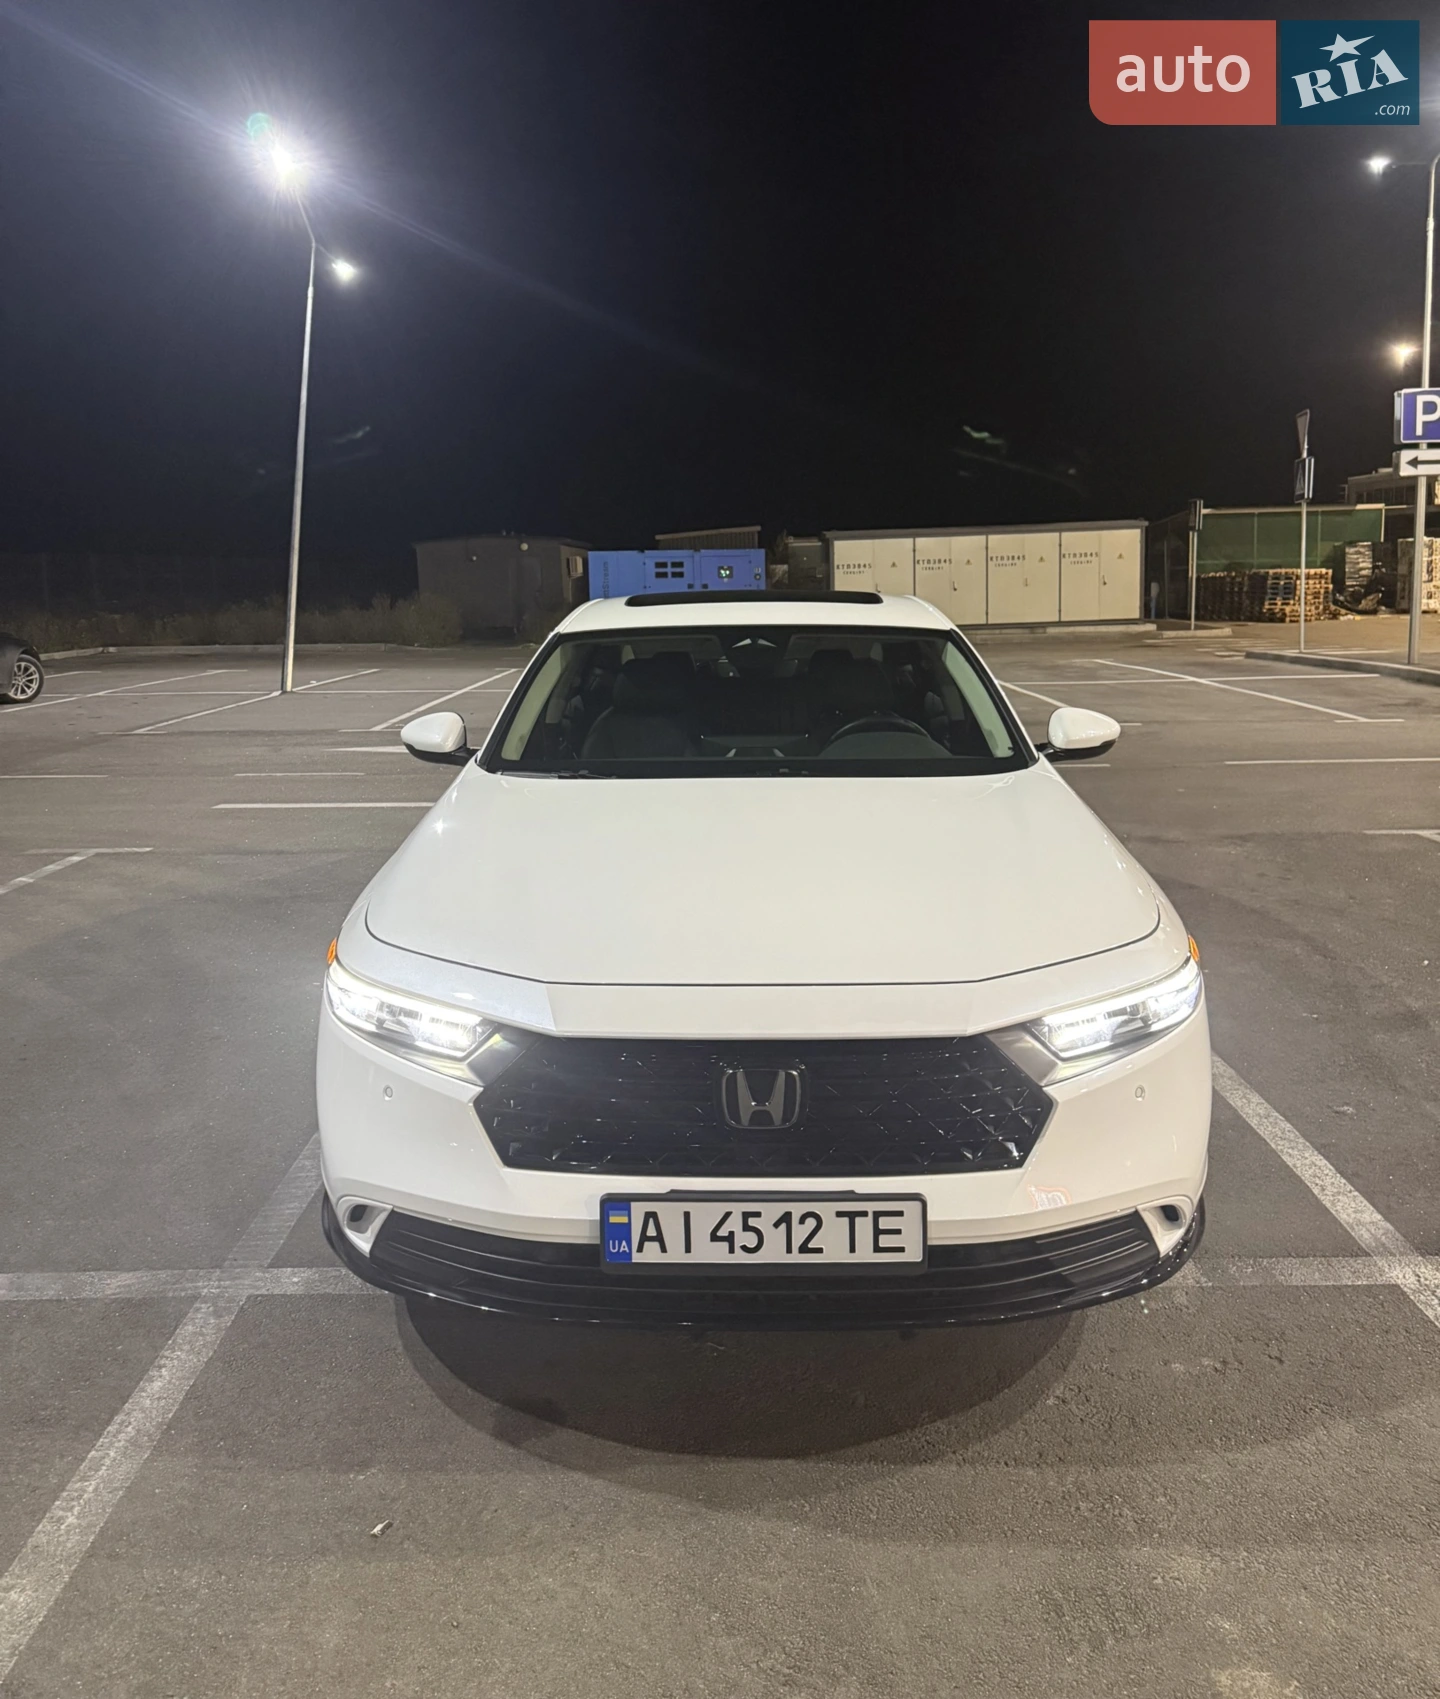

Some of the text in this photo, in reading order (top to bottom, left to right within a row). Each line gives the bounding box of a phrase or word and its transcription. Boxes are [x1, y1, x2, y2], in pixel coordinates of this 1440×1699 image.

[1415, 394, 1440, 436] P
[609, 1240, 629, 1253] UA
[635, 1209, 906, 1254] AI 4512 TE
